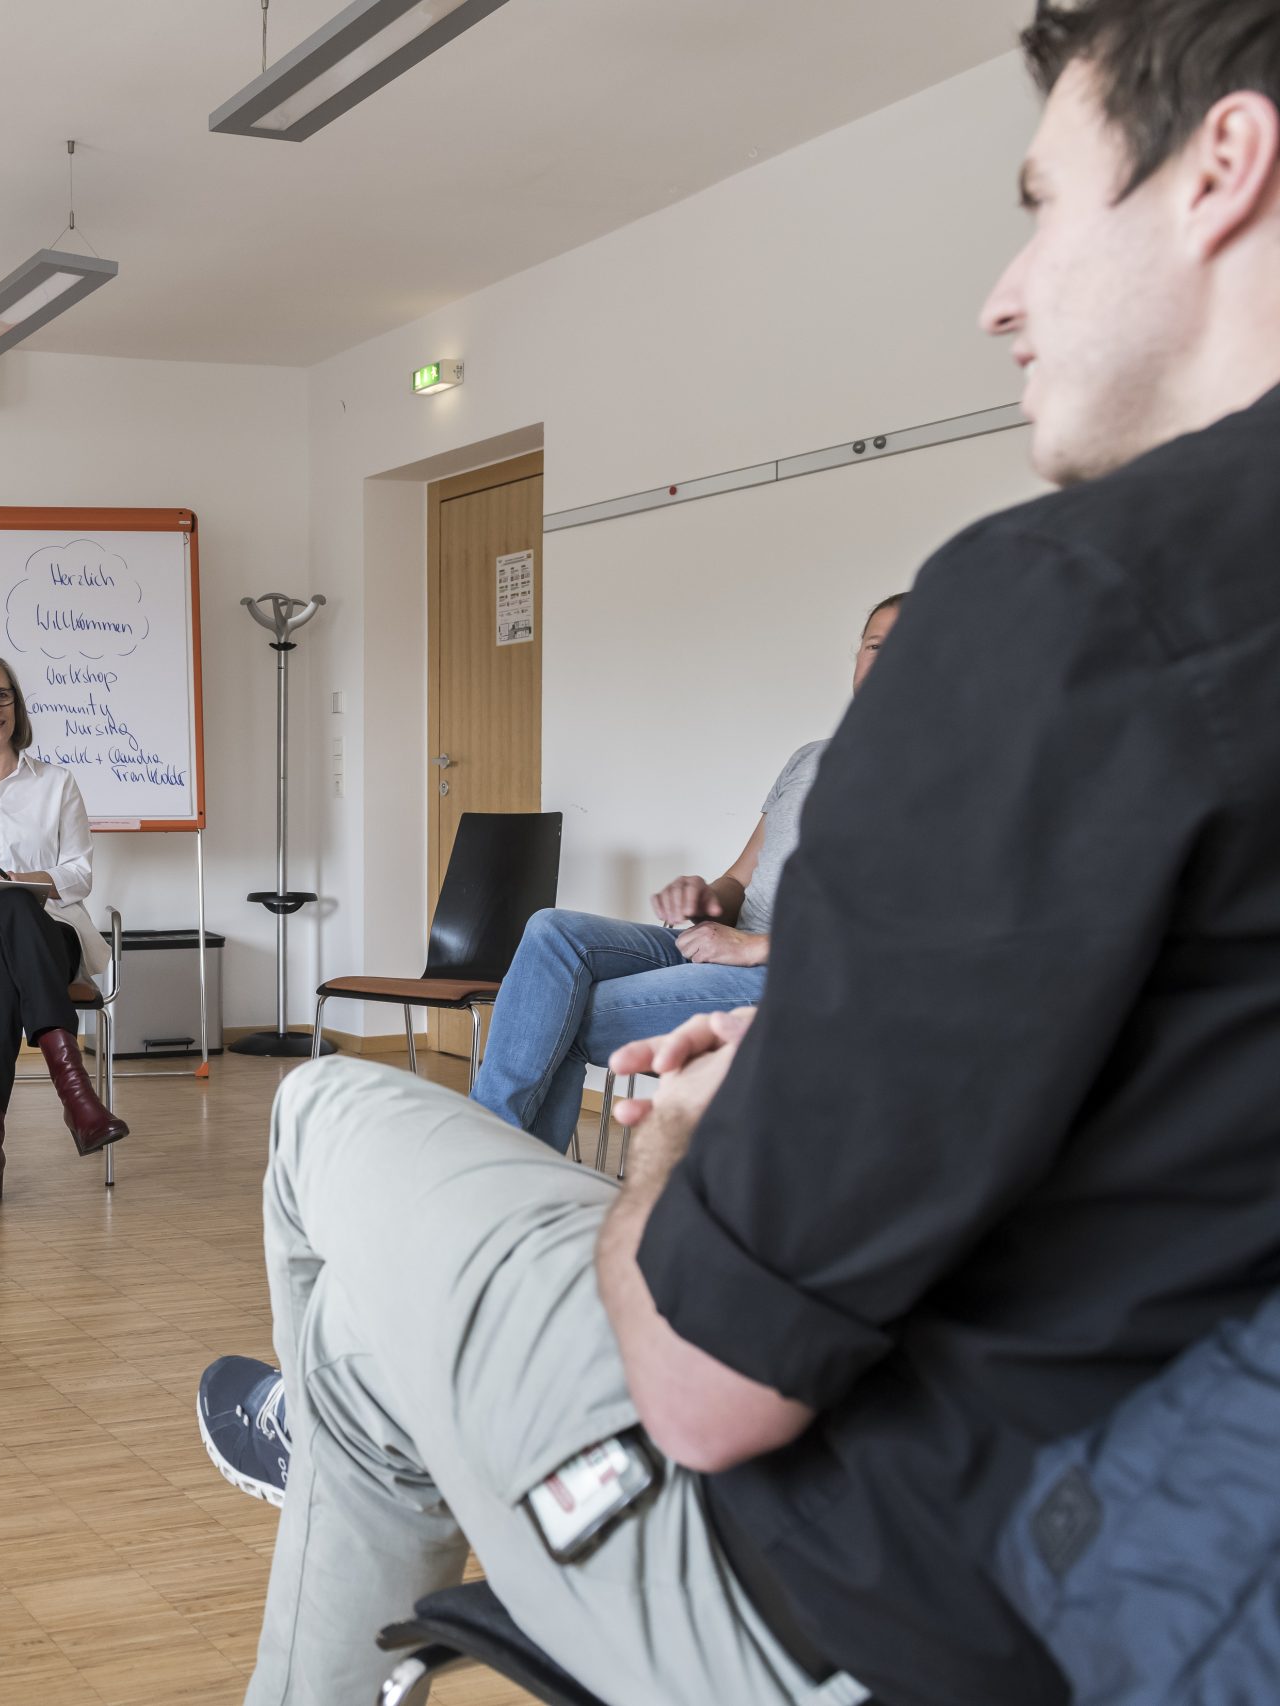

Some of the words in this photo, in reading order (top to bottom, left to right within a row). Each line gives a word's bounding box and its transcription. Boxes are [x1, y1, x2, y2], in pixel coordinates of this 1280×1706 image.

[49, 562, 115, 587] Herzlich
[35, 603, 133, 635] Willkommen
[65, 718, 139, 752] Nursing
